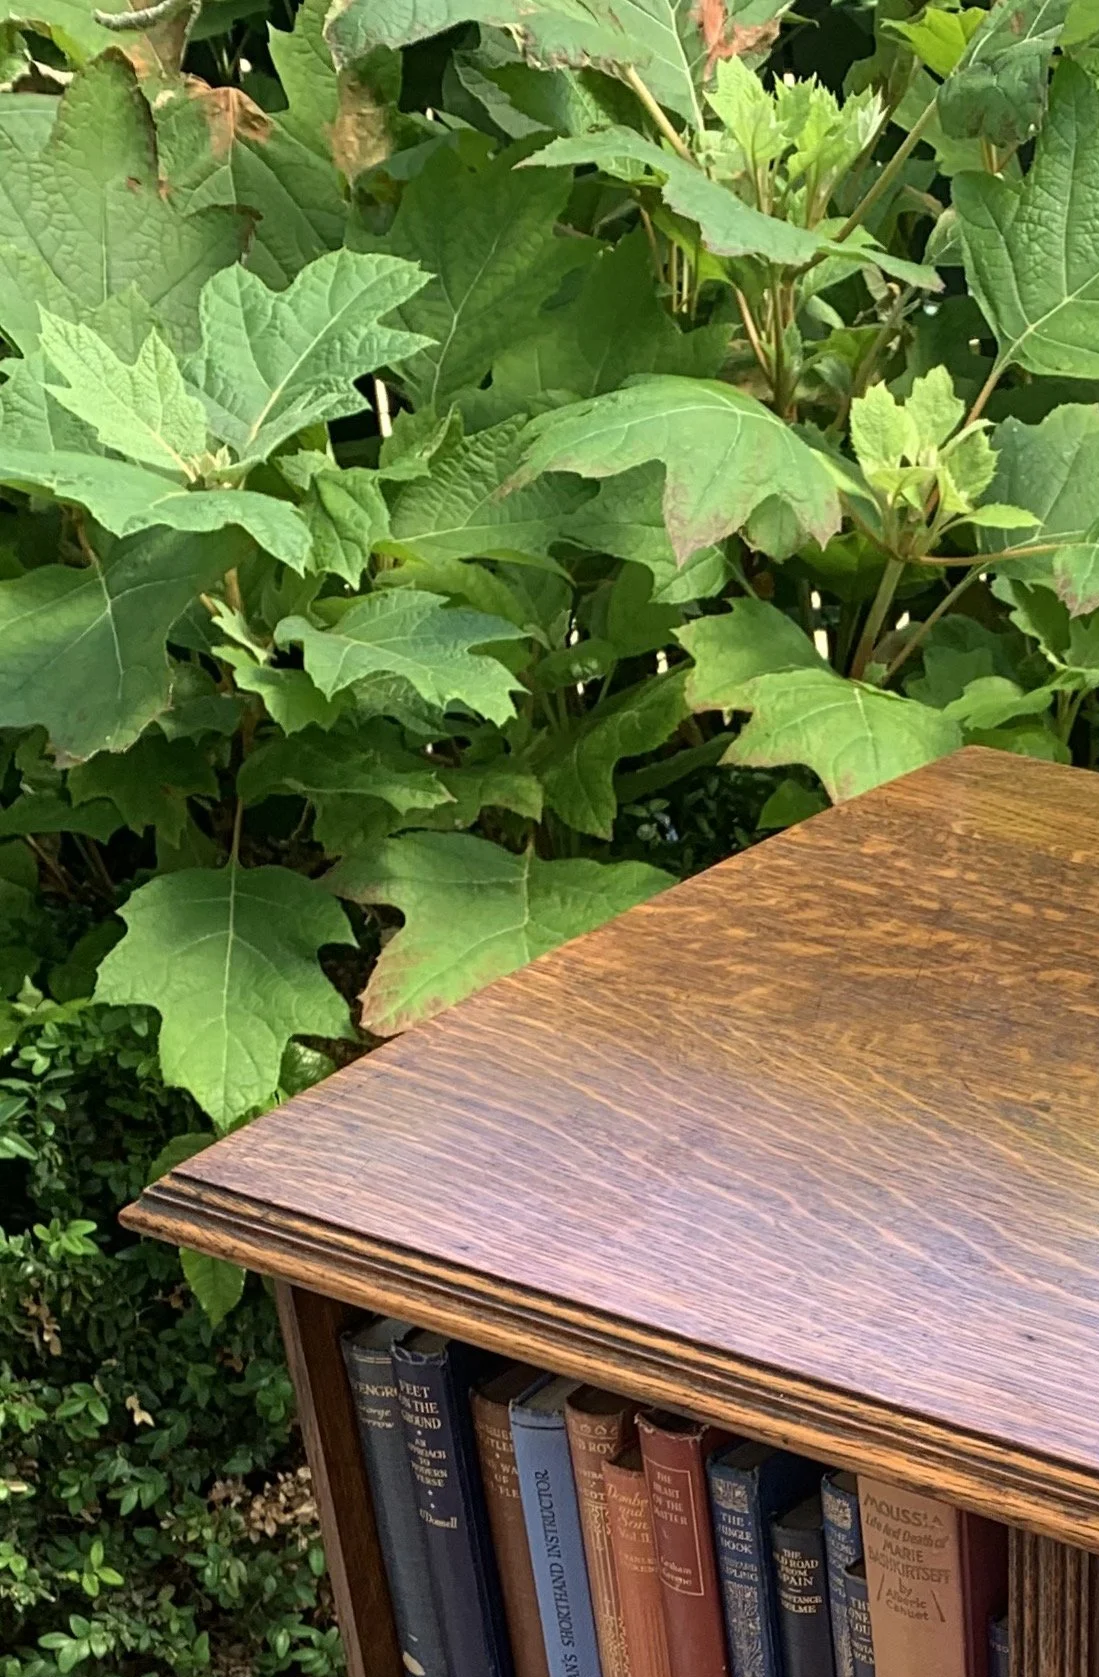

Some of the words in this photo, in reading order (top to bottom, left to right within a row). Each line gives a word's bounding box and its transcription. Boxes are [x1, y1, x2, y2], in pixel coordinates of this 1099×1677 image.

[413, 1402, 439, 1415] THE
[588, 1442, 616, 1455] ROY
[657, 1471, 671, 1484] THE
[534, 1468, 562, 1560] INSTRUCTOR
[666, 1500, 683, 1512] THE
[721, 1511, 744, 1527] THE
[865, 1513, 883, 1532] Life
[903, 1530, 933, 1547] Death
[720, 1536, 753, 1555] BOOK
[882, 1539, 924, 1563] MARIE
[783, 1548, 802, 1560] THE
[789, 1558, 819, 1570] ROAD
[899, 1577, 912, 1597] by
[549, 1562, 576, 1648] SHORTHAND
